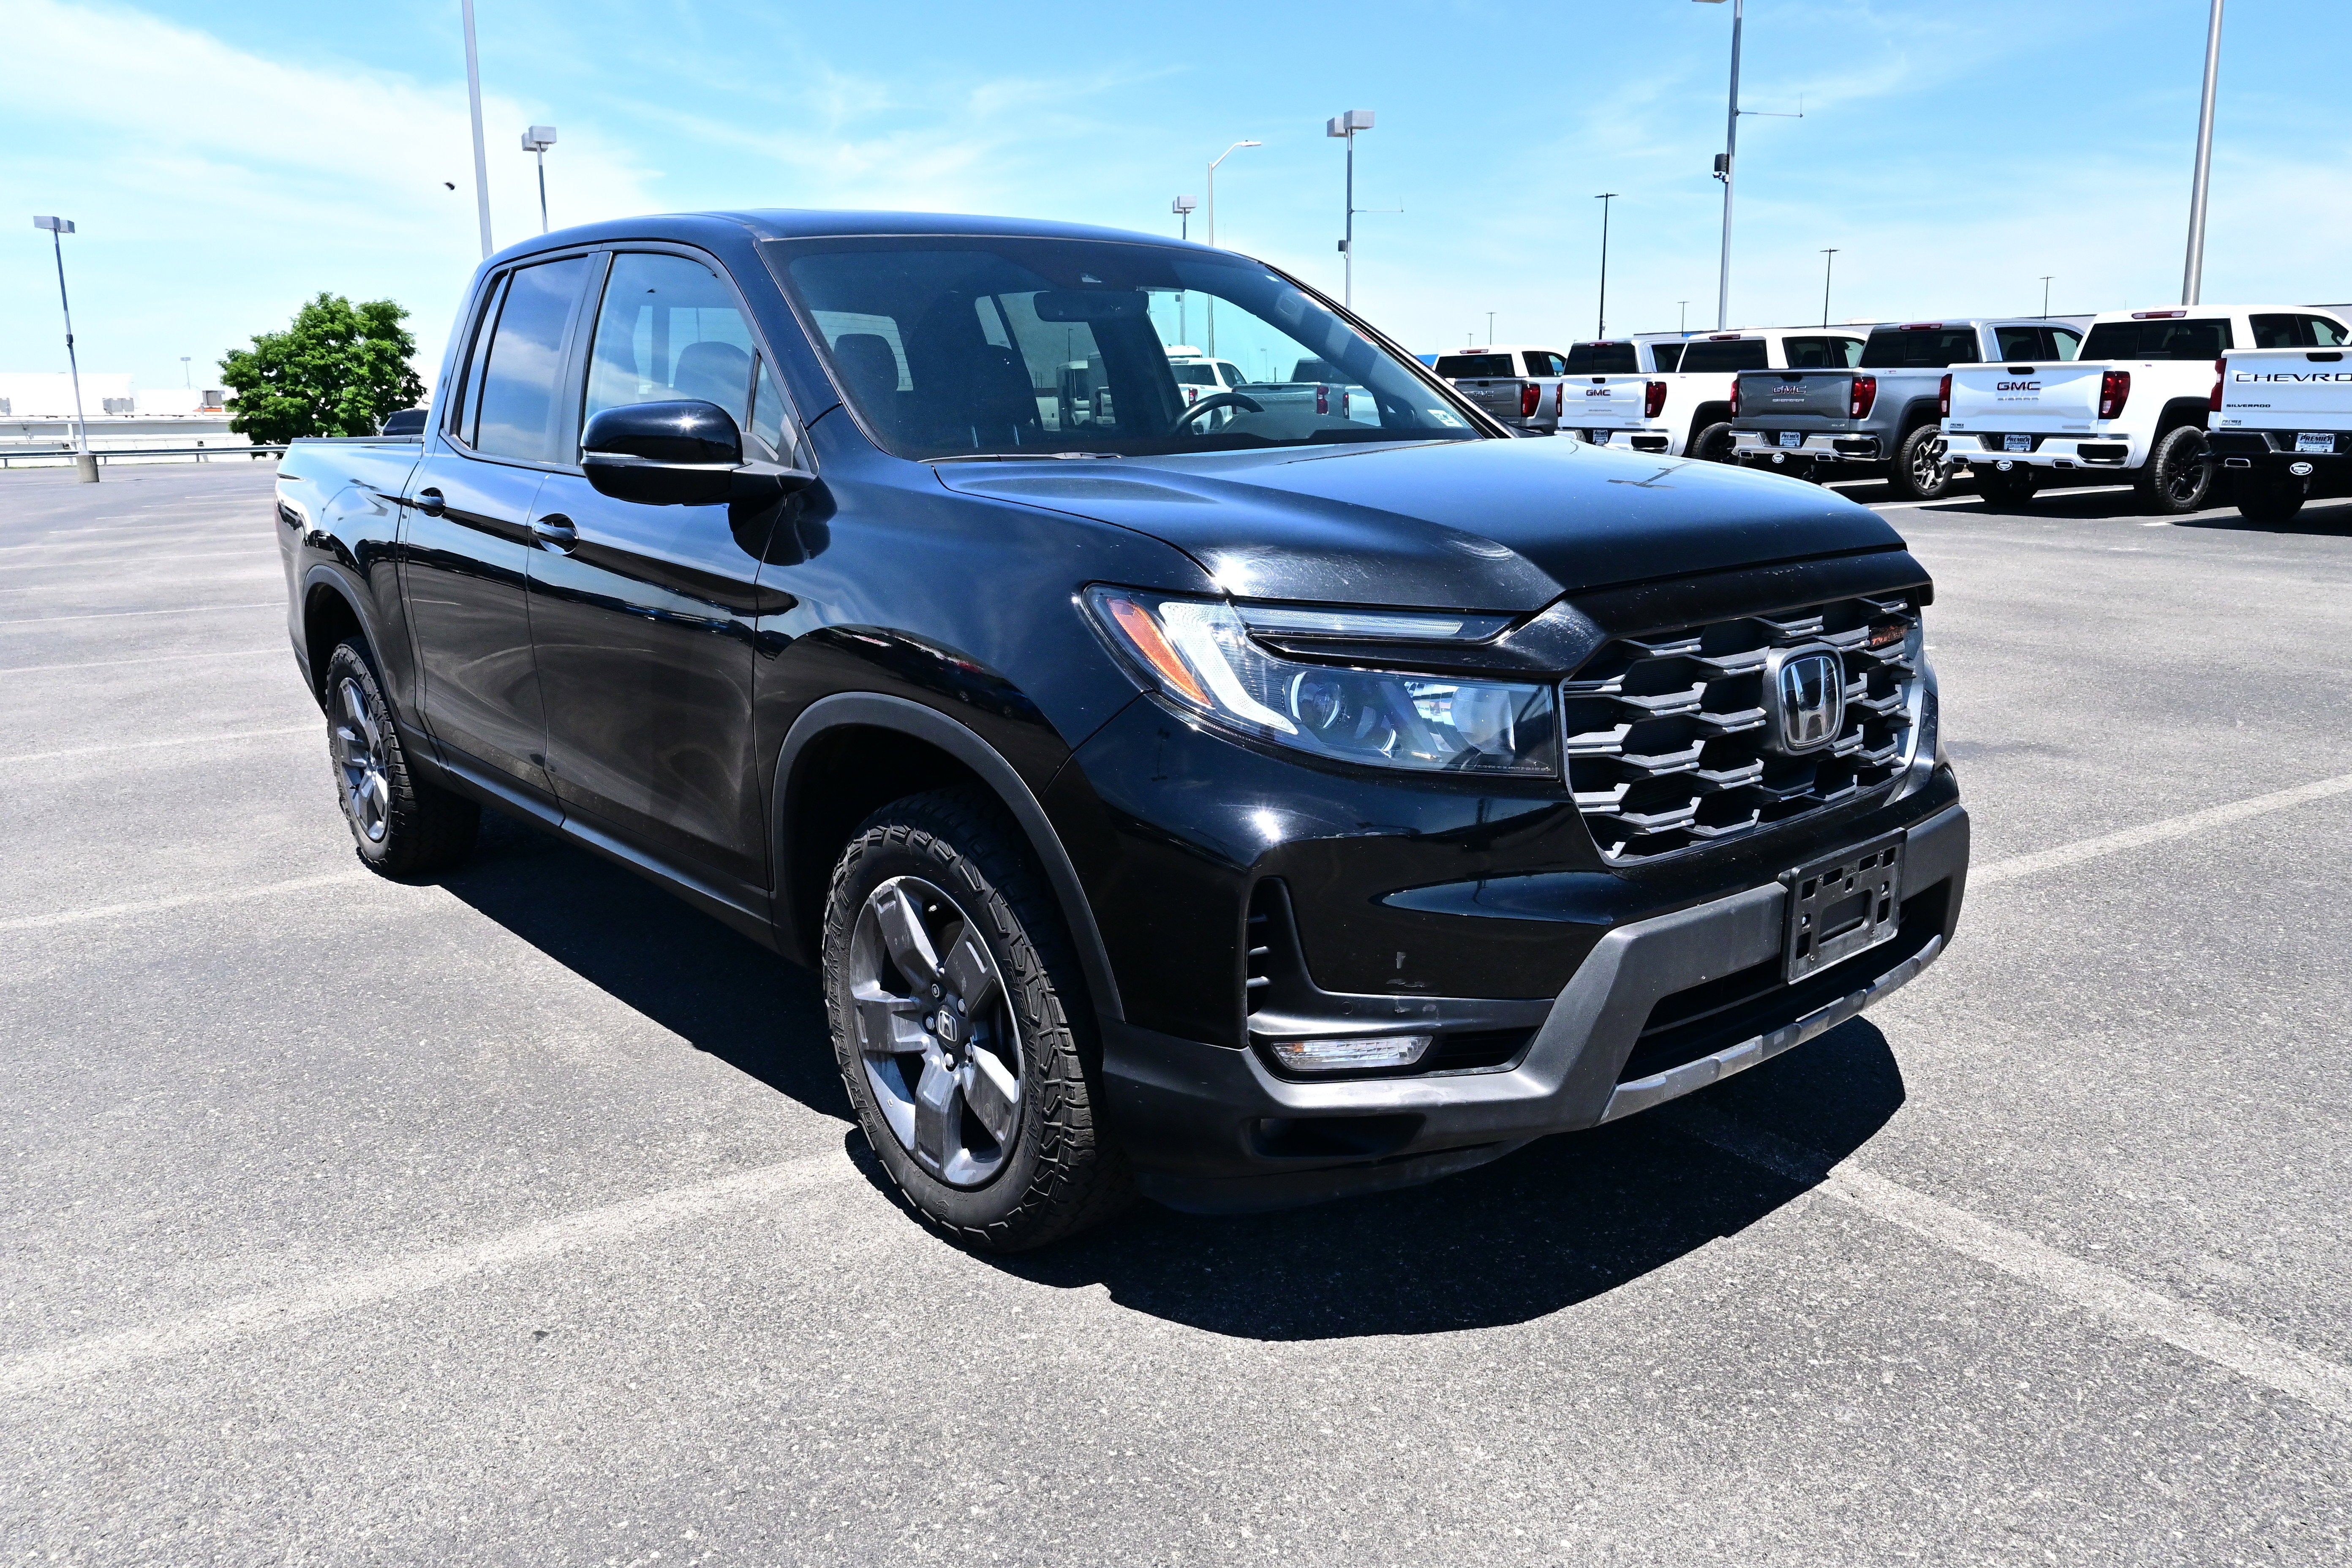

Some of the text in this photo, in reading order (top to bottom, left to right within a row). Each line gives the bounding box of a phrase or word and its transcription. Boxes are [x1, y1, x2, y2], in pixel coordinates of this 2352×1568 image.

[2236, 373, 2352, 382] CHEVRO
[1772, 385, 1807, 394] GMC
[1997, 381, 2042, 391] GMC
[2006, 436, 2030, 444] PREMIER
[2300, 435, 2333, 444] PREMIER
[828, 952, 878, 1134] GRABBER
